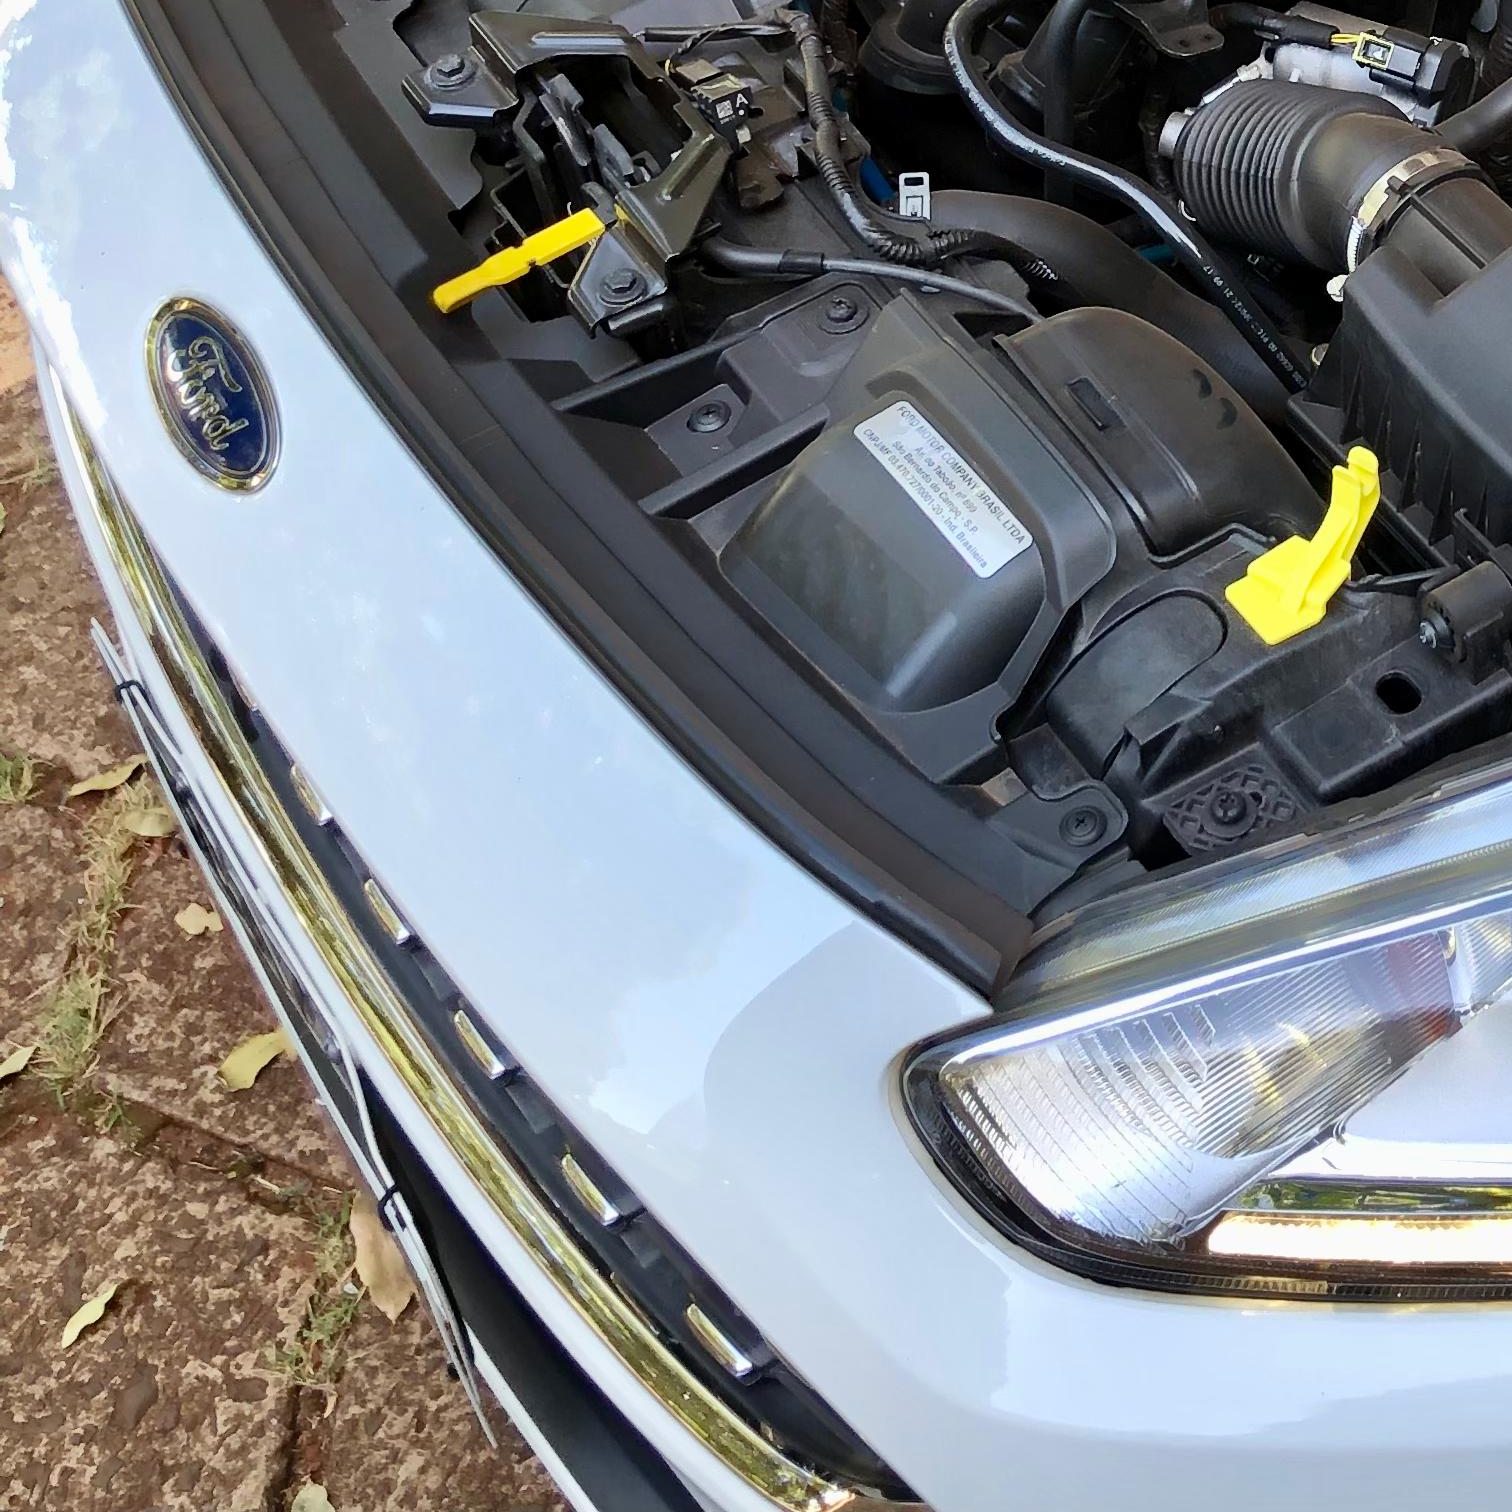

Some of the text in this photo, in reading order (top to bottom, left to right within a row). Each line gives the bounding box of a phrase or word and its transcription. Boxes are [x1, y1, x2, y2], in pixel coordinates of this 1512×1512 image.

[735, 92, 749, 108] A
[166, 335, 250, 451] Ford
[897, 404, 1026, 544] FORD MOTOR COMPANY BRASIL LTDA
[954, 532, 989, 568] Brasileira
